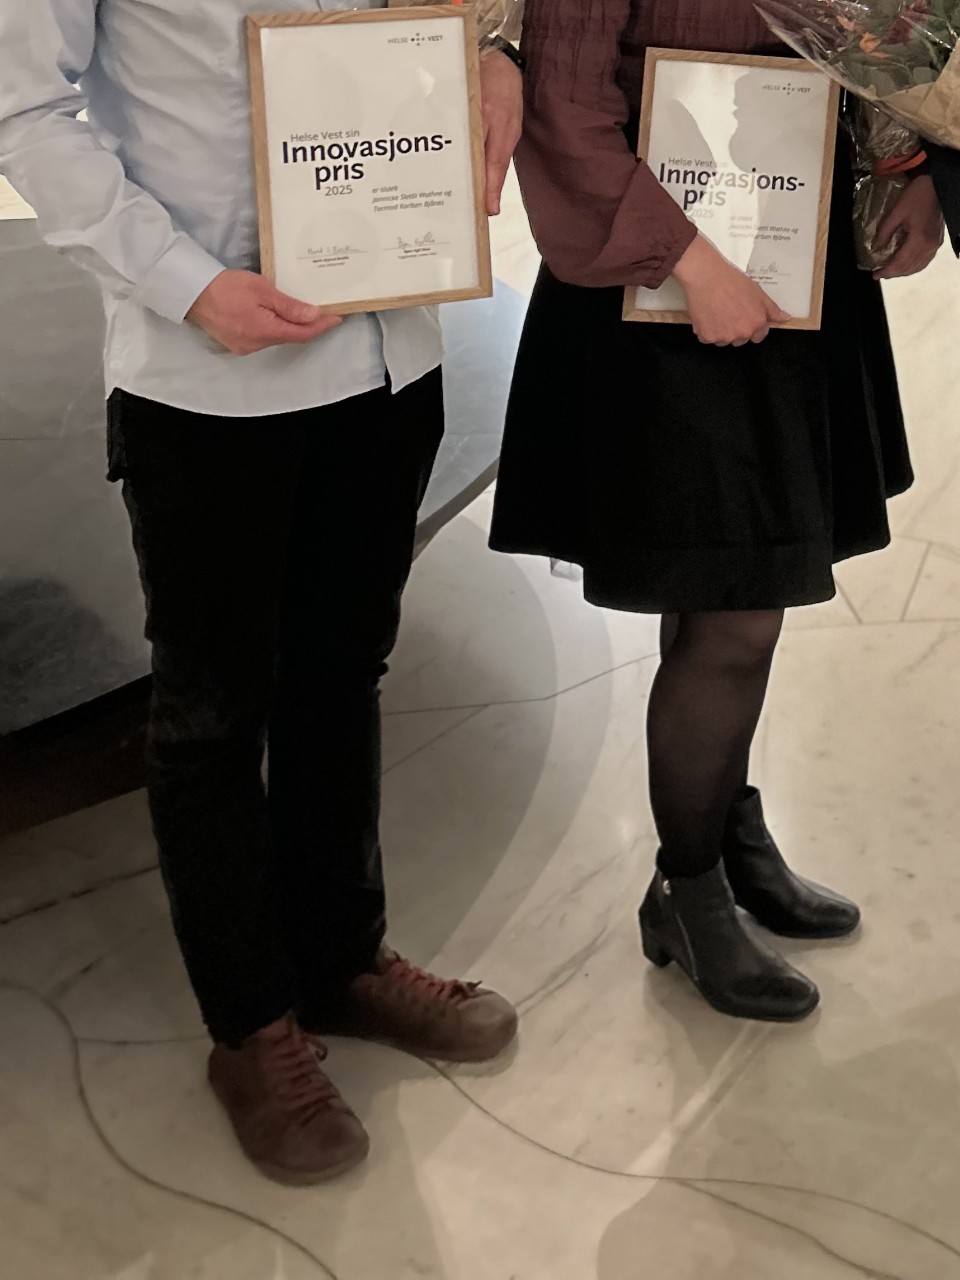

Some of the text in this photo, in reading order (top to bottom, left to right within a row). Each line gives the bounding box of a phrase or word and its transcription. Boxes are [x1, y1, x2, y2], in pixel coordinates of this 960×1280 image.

[282, 131, 453, 164] Innovasjons-
[290, 129, 360, 142] Helse Vest sin
[315, 157, 365, 191] pris
[668, 157, 693, 166] Helse
[694, 159, 713, 168] Vest
[324, 184, 353, 197] 2025
[659, 162, 805, 194] Innovasjons-
[683, 183, 726, 210] pris
